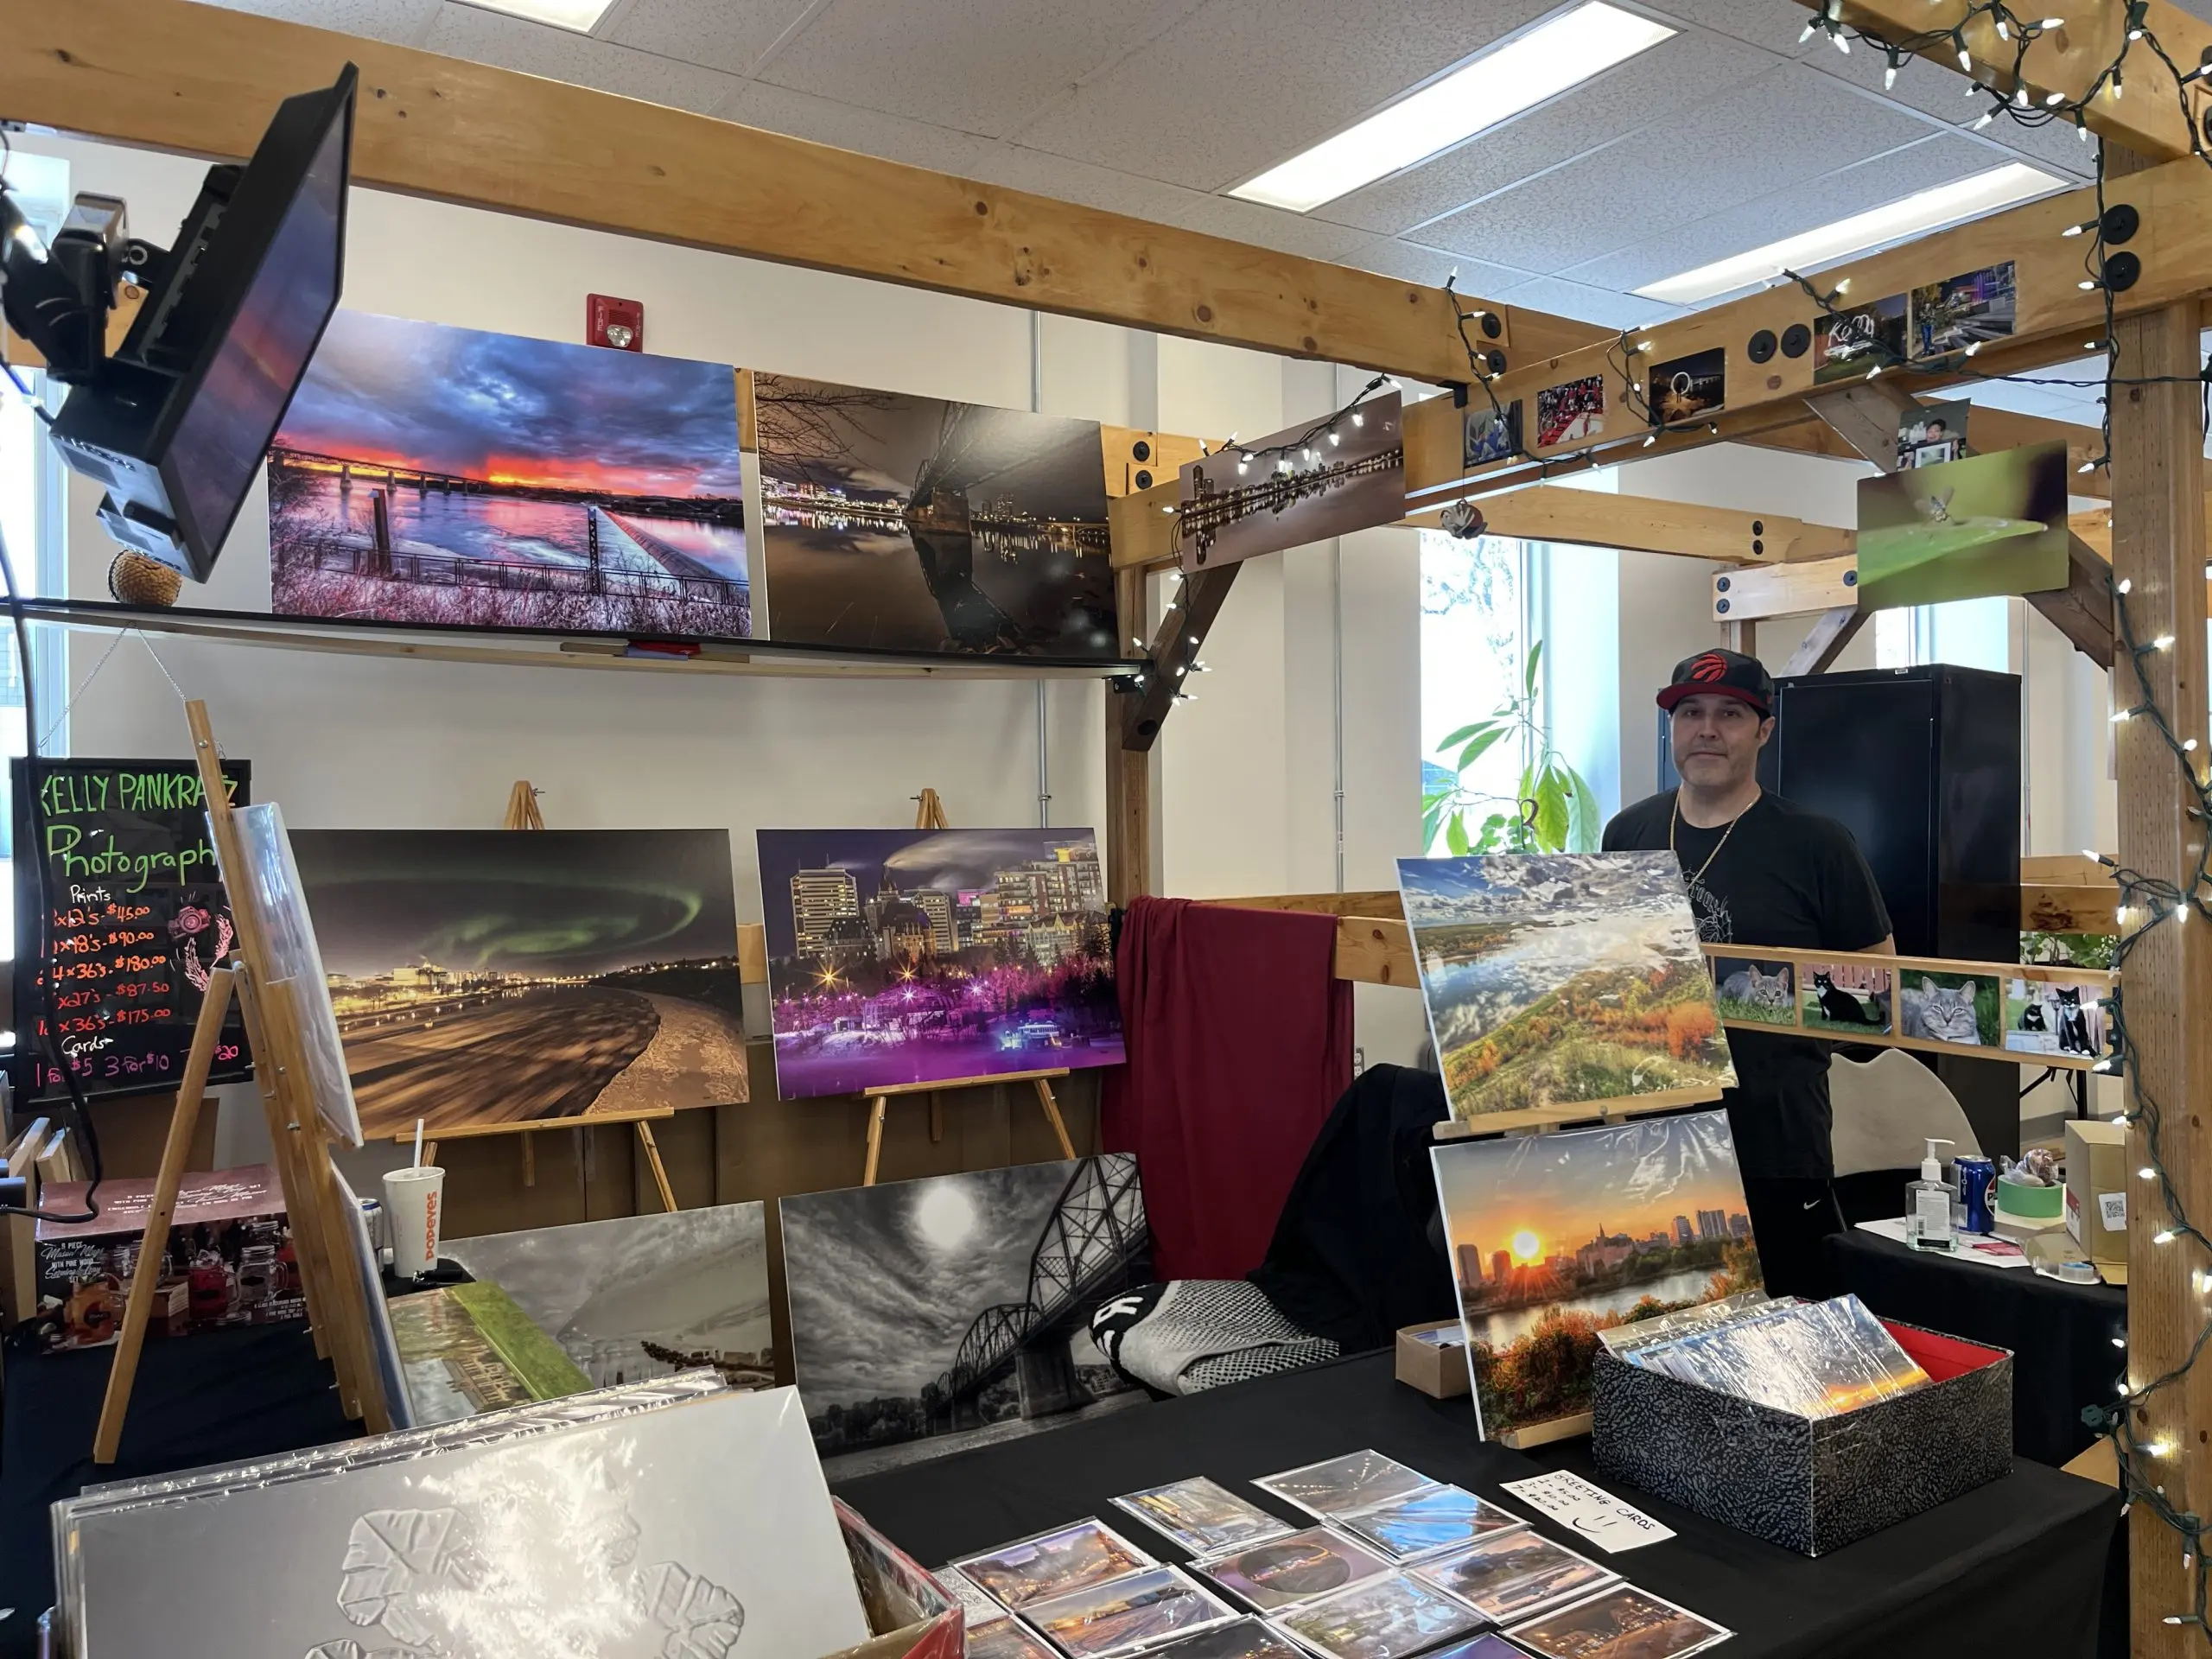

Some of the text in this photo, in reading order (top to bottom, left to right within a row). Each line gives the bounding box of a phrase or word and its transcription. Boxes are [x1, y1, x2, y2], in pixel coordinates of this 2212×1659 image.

[119, 772, 238, 811] PANKRAZ
[46, 824, 217, 893] Photograph
[70, 884, 111, 904] Prints
[70, 1056, 93, 1077] $5
[105, 1055, 120, 1077] 3
[121, 1055, 146, 1074] for
[1554, 1473, 1656, 1531] GREETING CARDS
